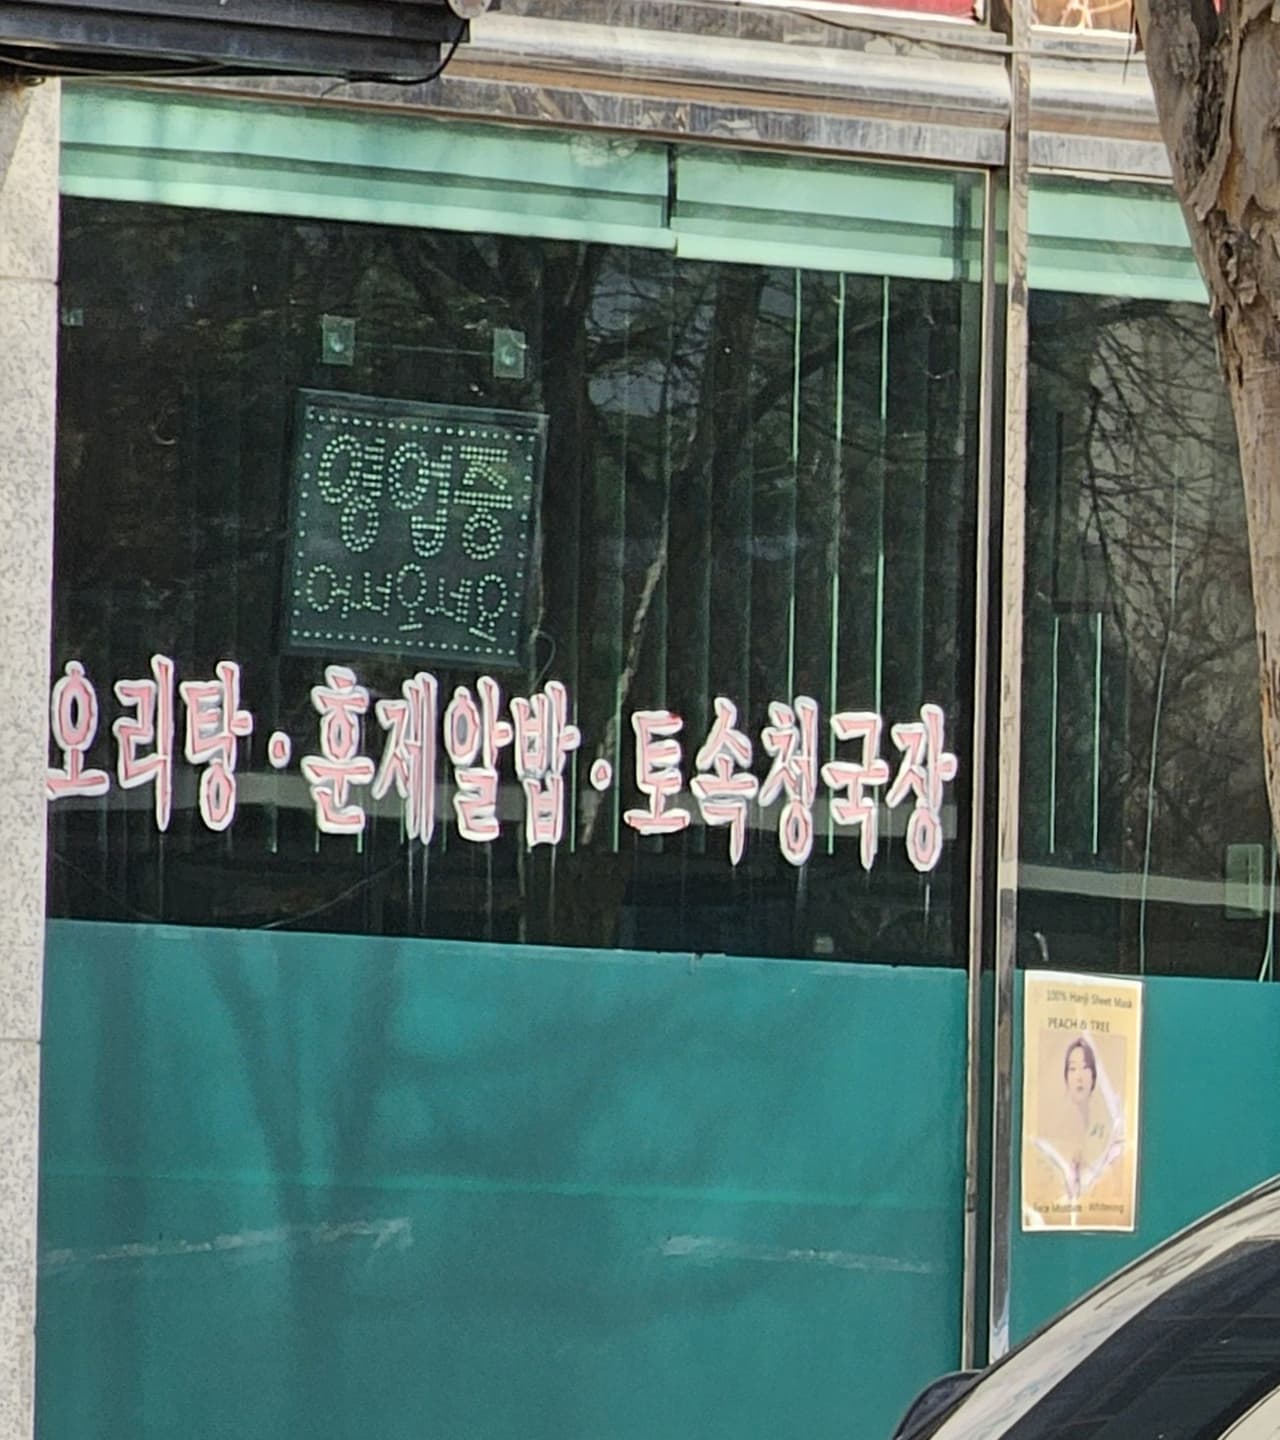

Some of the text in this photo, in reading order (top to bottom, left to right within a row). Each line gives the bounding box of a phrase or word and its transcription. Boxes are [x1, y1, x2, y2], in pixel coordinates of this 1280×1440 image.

[318, 434, 513, 560] 영업중
[306, 563, 508, 642] 어서오세요
[1047, 1016, 1078, 1030] PEACH
[1090, 1019, 1111, 1033] TREE
